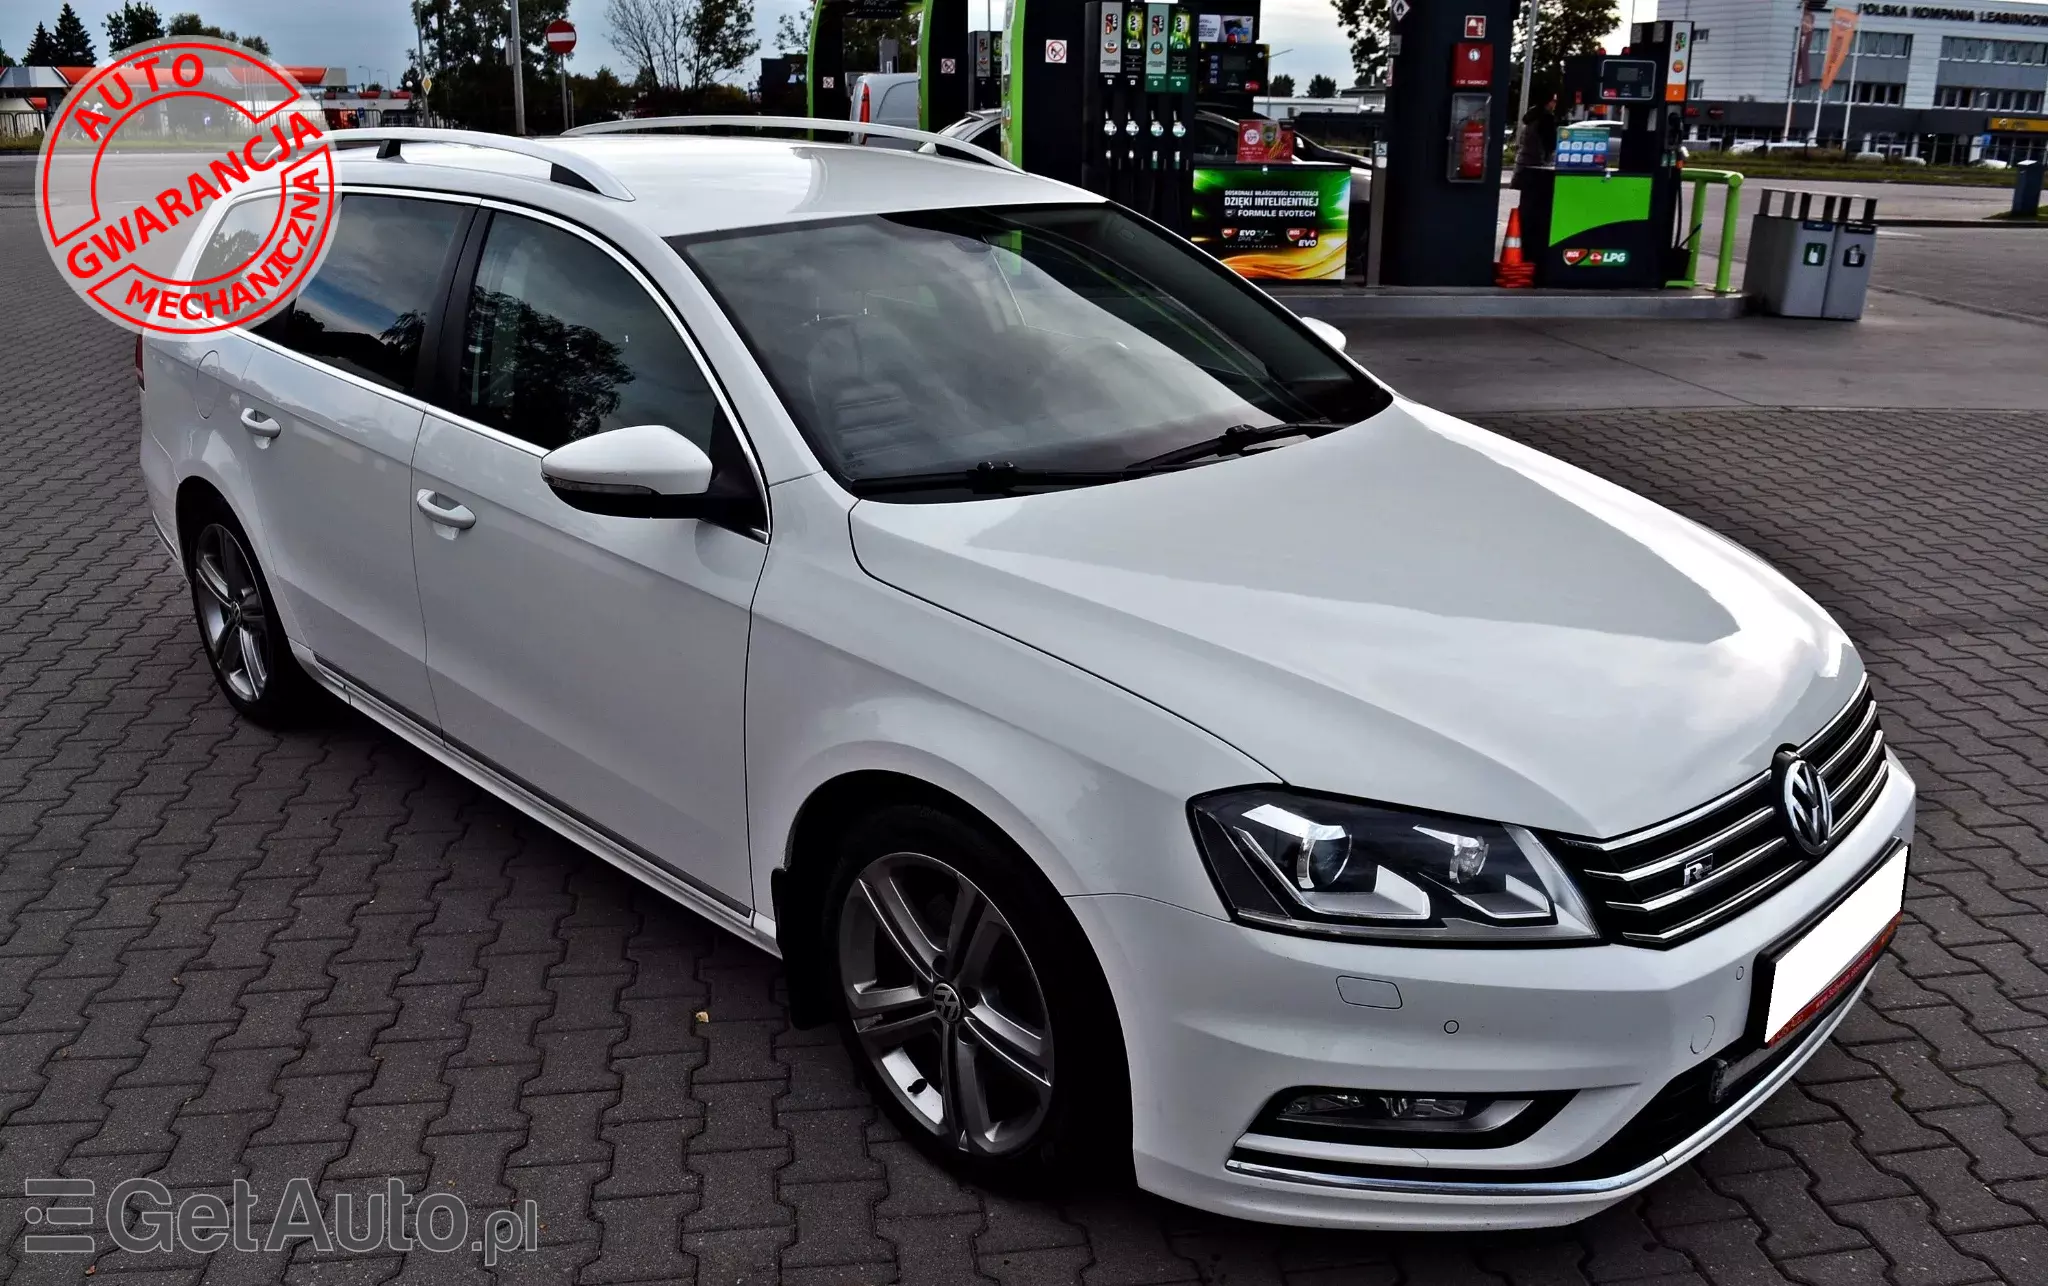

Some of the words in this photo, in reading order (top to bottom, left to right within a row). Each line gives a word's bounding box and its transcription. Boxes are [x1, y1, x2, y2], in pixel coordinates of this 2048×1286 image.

[1912, 6, 1973, 21] KOMPANIA
[1224, 197, 1252, 209] DZIĘKI
[1254, 197, 1319, 206] INTELIGENTNEJ
[1298, 239, 1317, 247] EVO
[1602, 252, 1626, 262] LPG
